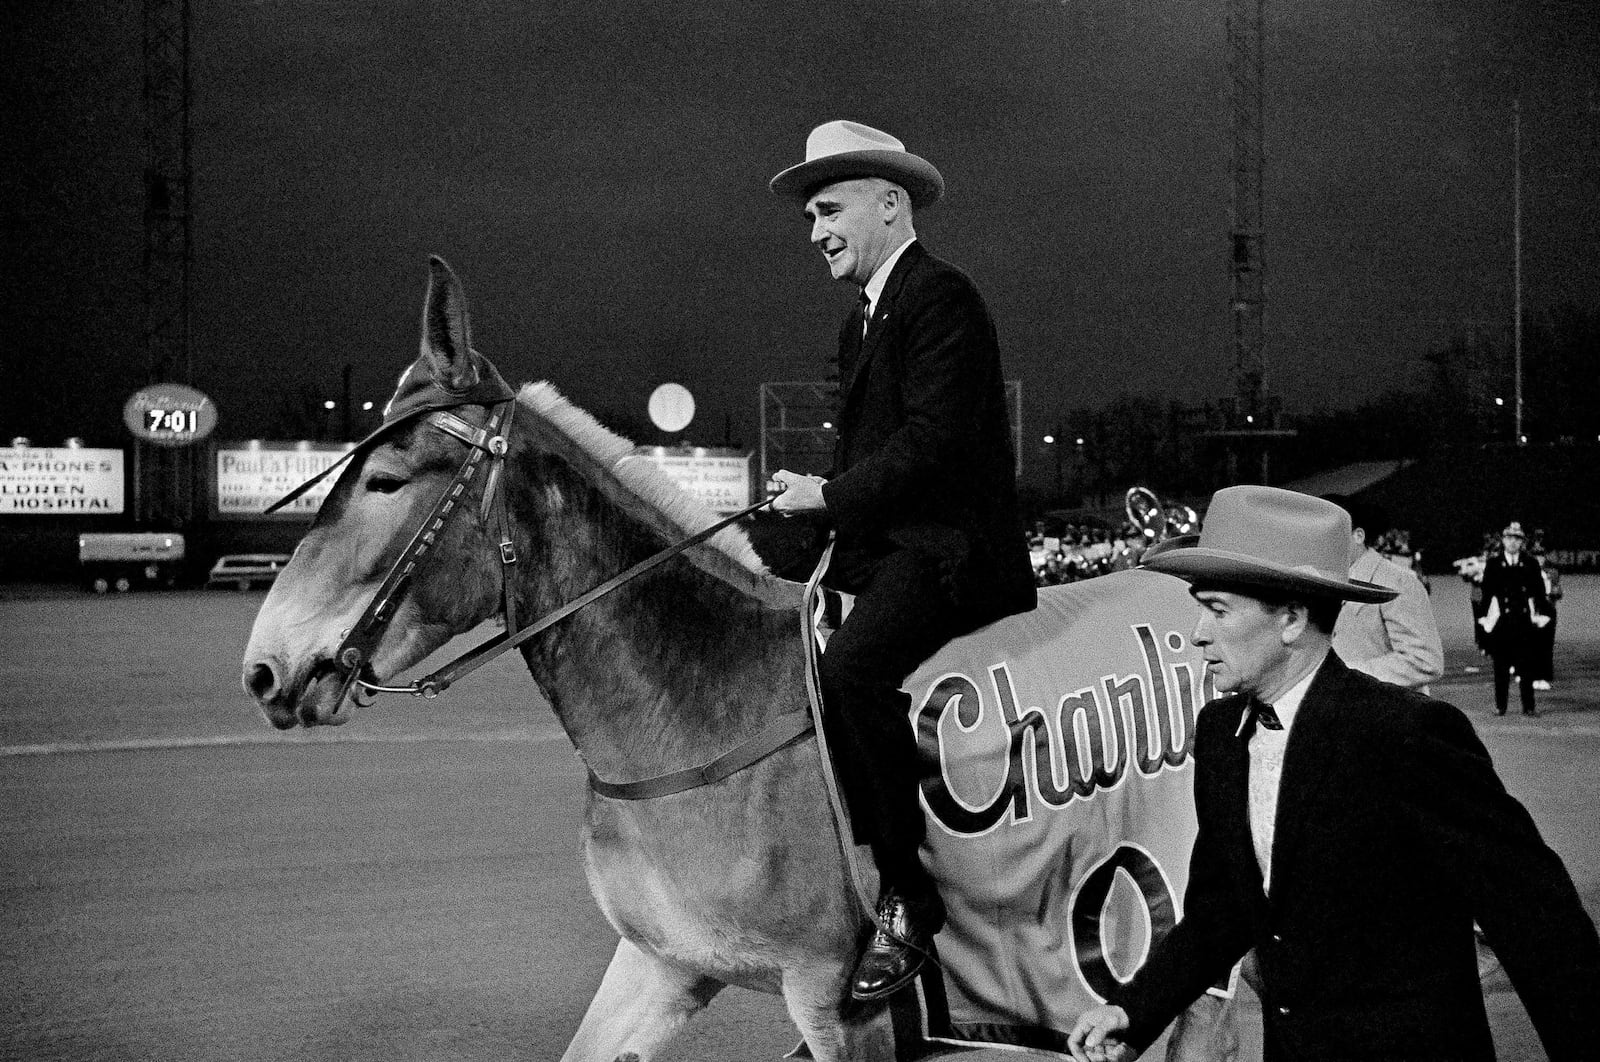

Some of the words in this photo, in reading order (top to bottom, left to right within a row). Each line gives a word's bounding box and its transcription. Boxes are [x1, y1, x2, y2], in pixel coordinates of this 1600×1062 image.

[150, 409, 197, 433] 7:01
[13, 498, 113, 509] HOSPITAL
[1067, 840, 1185, 1005] O
